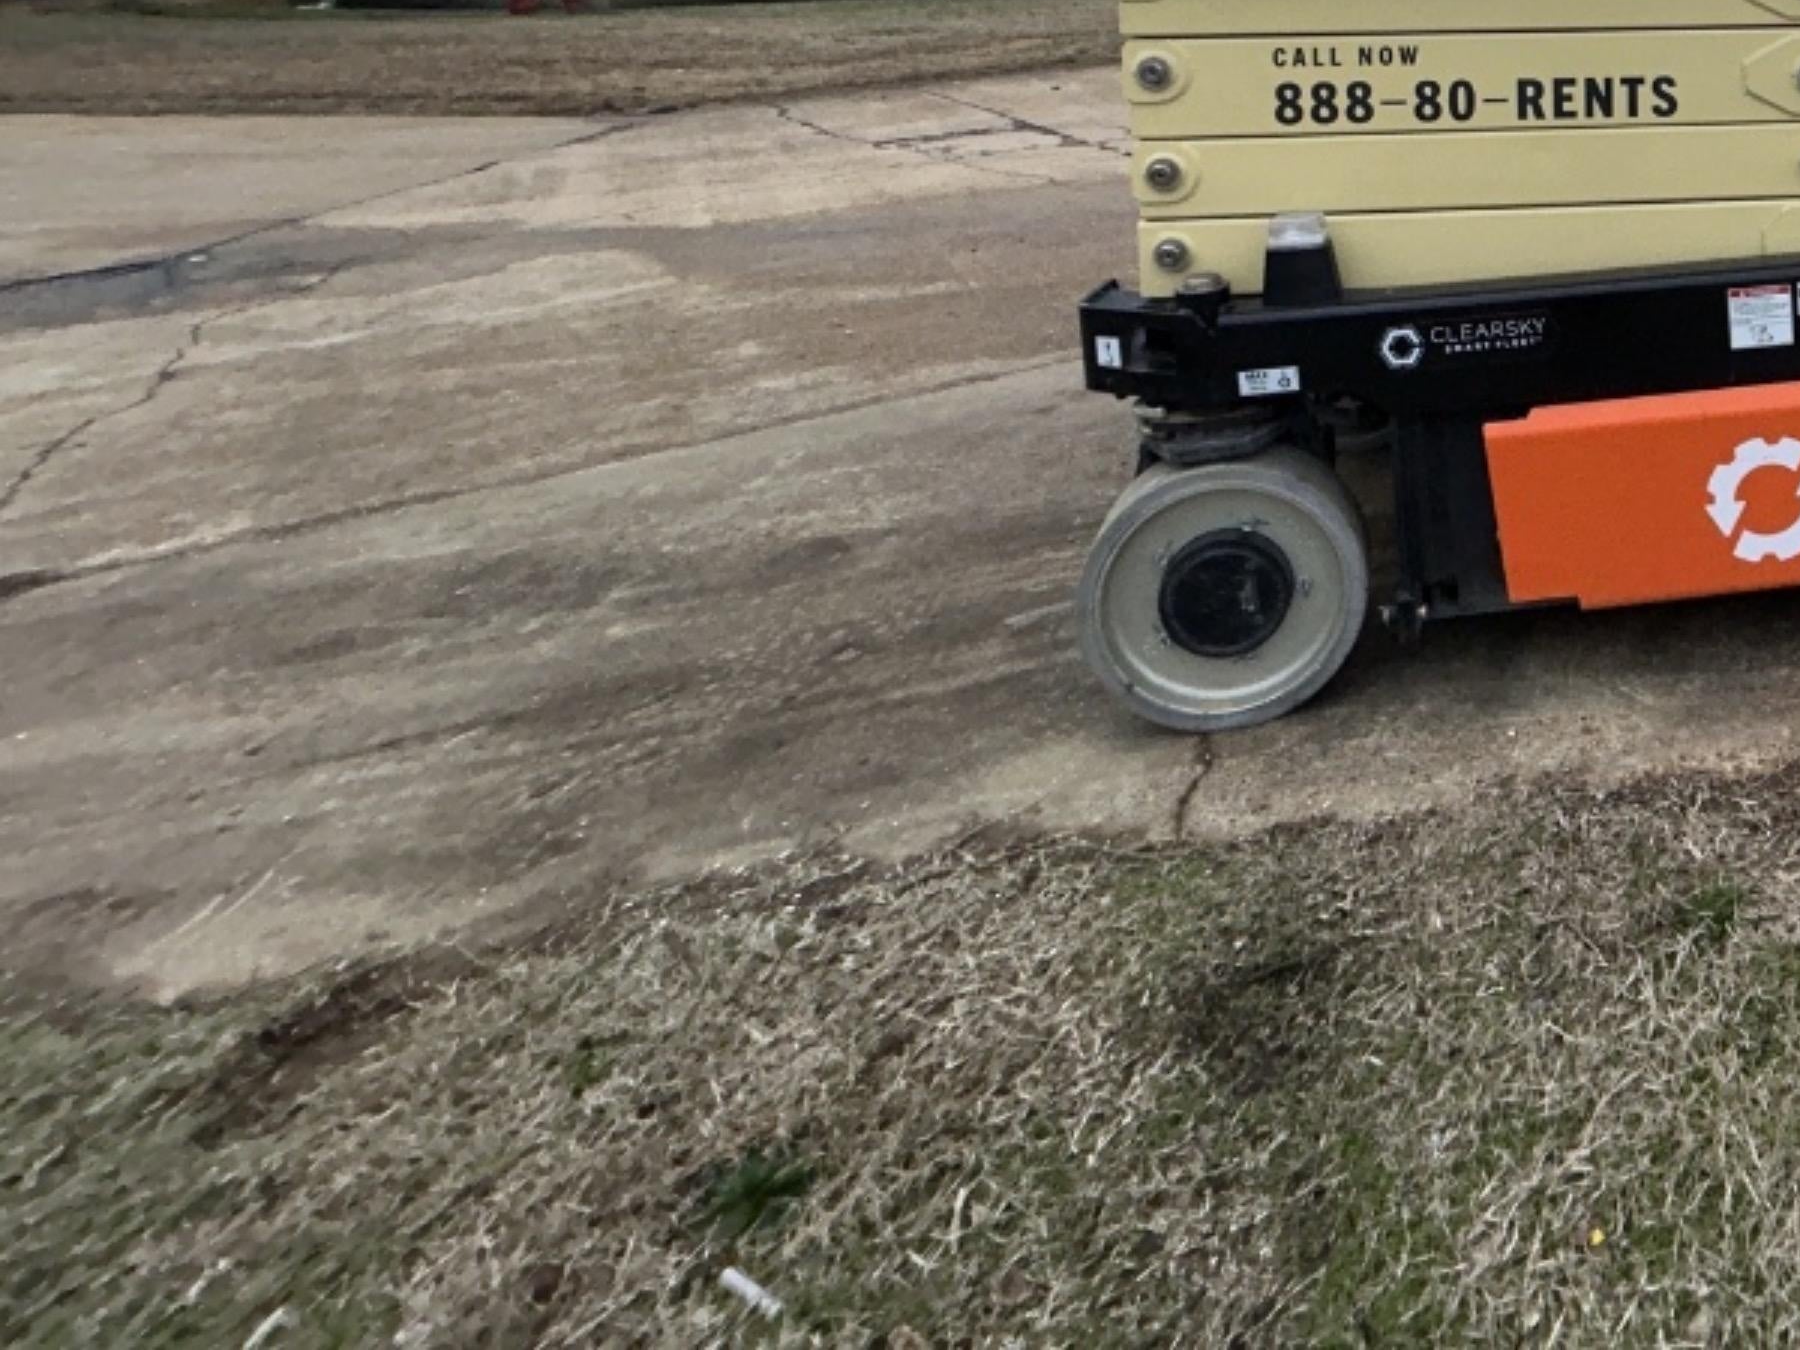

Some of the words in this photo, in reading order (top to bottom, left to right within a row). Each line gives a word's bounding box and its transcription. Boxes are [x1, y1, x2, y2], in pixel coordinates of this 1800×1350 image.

[1272, 47, 1342, 67] CALL
[1358, 46, 1420, 66] NOW
[1430, 317, 1547, 343] CLEARSKY
